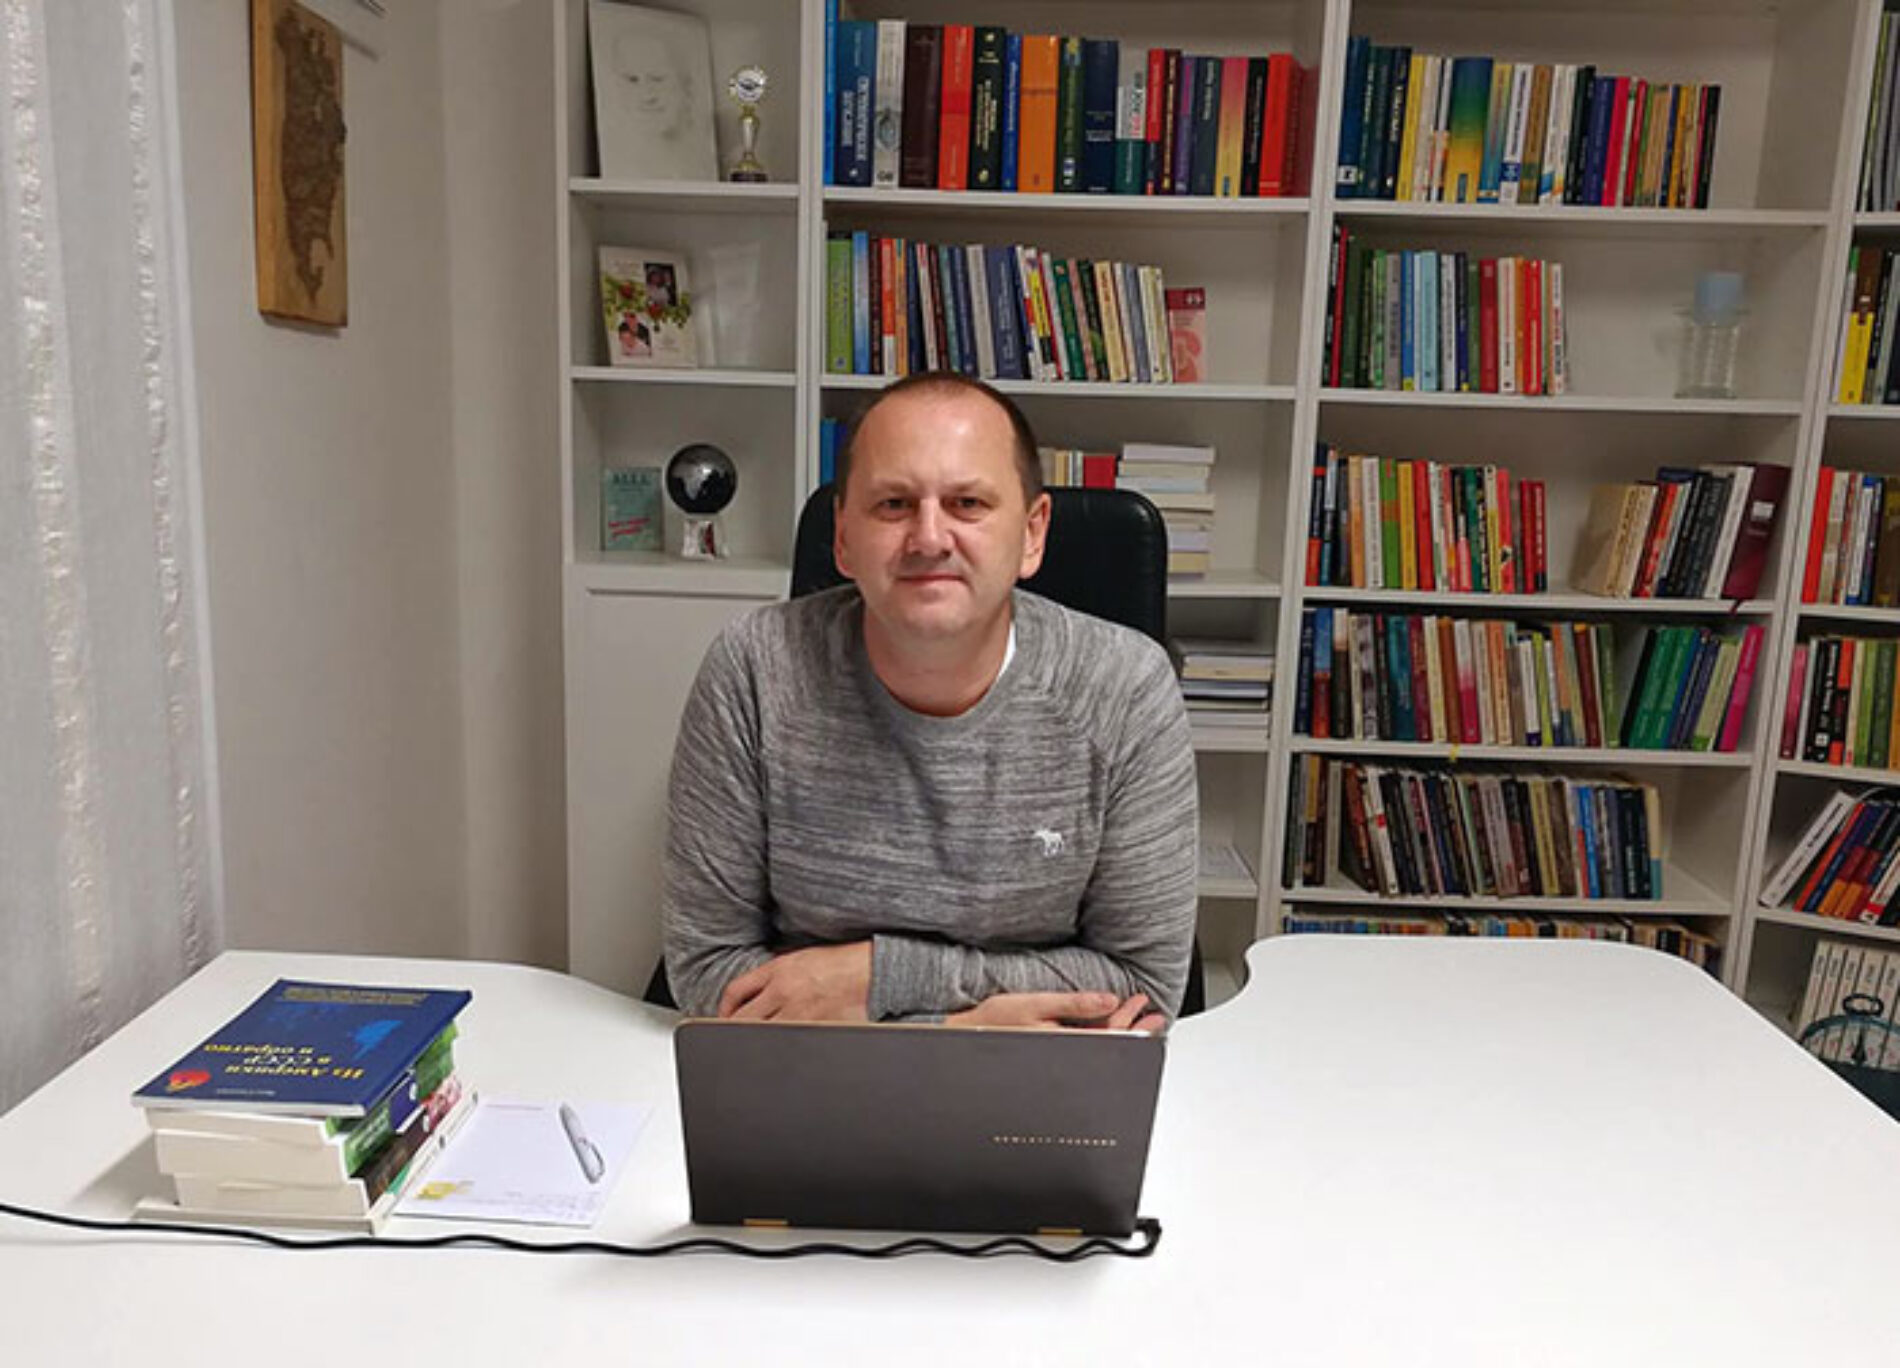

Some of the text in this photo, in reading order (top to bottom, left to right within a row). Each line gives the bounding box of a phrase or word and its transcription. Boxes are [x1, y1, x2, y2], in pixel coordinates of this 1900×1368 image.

[203, 1043, 295, 1056] обратно
[243, 1055, 313, 1065] СССР
[224, 1063, 329, 1077] Америки
